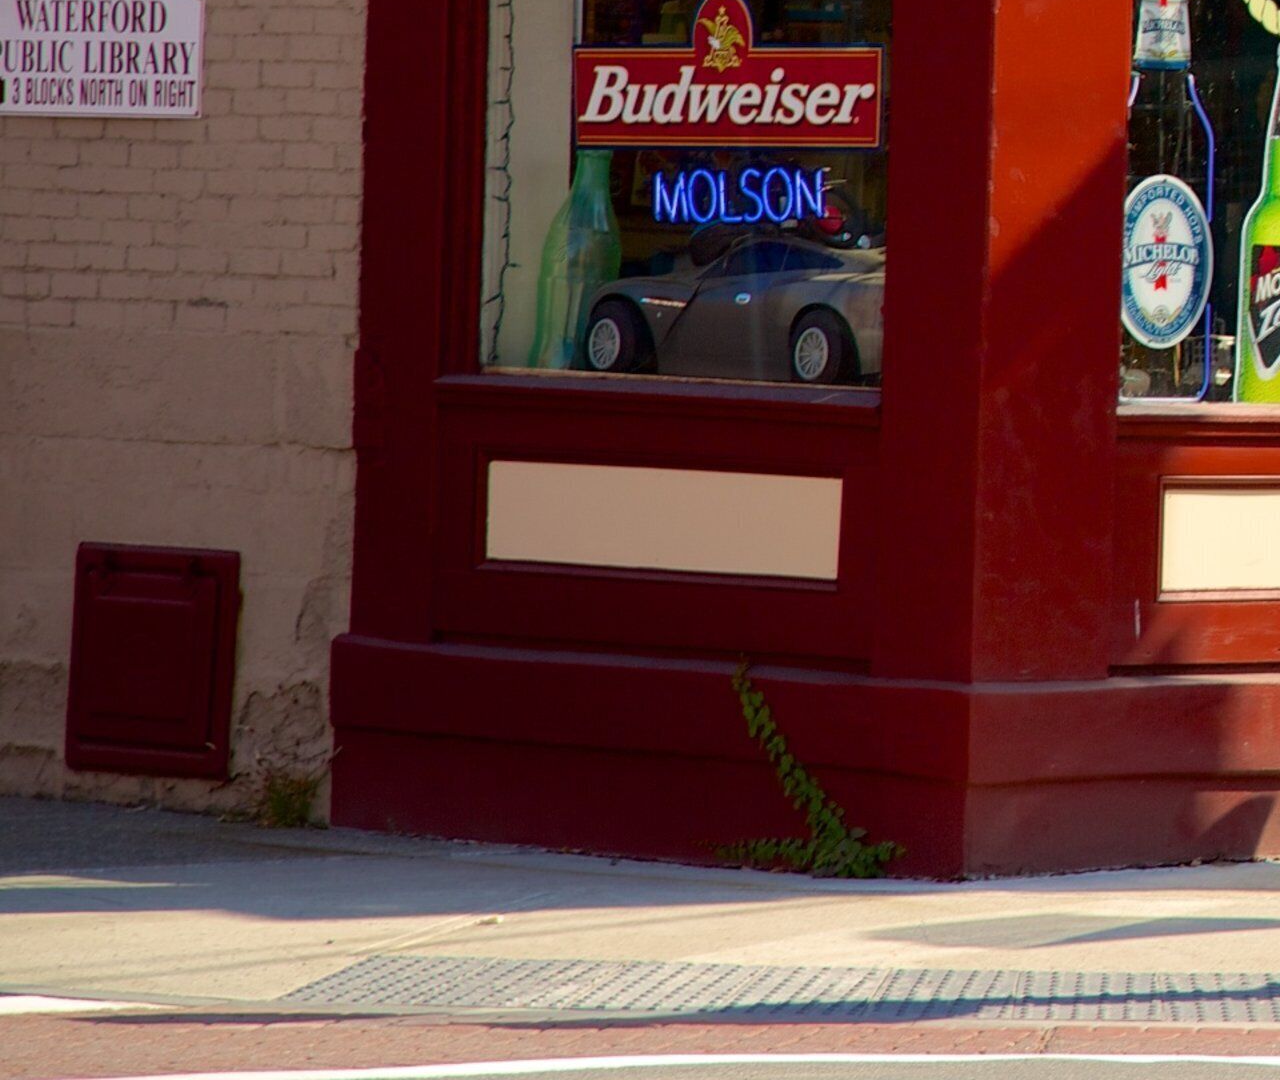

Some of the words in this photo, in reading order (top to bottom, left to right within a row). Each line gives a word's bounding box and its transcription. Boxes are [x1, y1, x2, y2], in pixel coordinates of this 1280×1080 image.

[16, 0, 167, 33] WATERFORD
[83, 41, 196, 75] LIBRARY
[11, 78, 20, 105] 3
[25, 78, 75, 106] BLOCKS
[80, 79, 123, 107] NORTH
[129, 80, 148, 108] ON
[154, 80, 197, 109] RIGHT
[578, 64, 875, 125] Budweiser
[654, 166, 826, 223] MOLSON
[1123, 245, 1200, 268] MICHELOB
